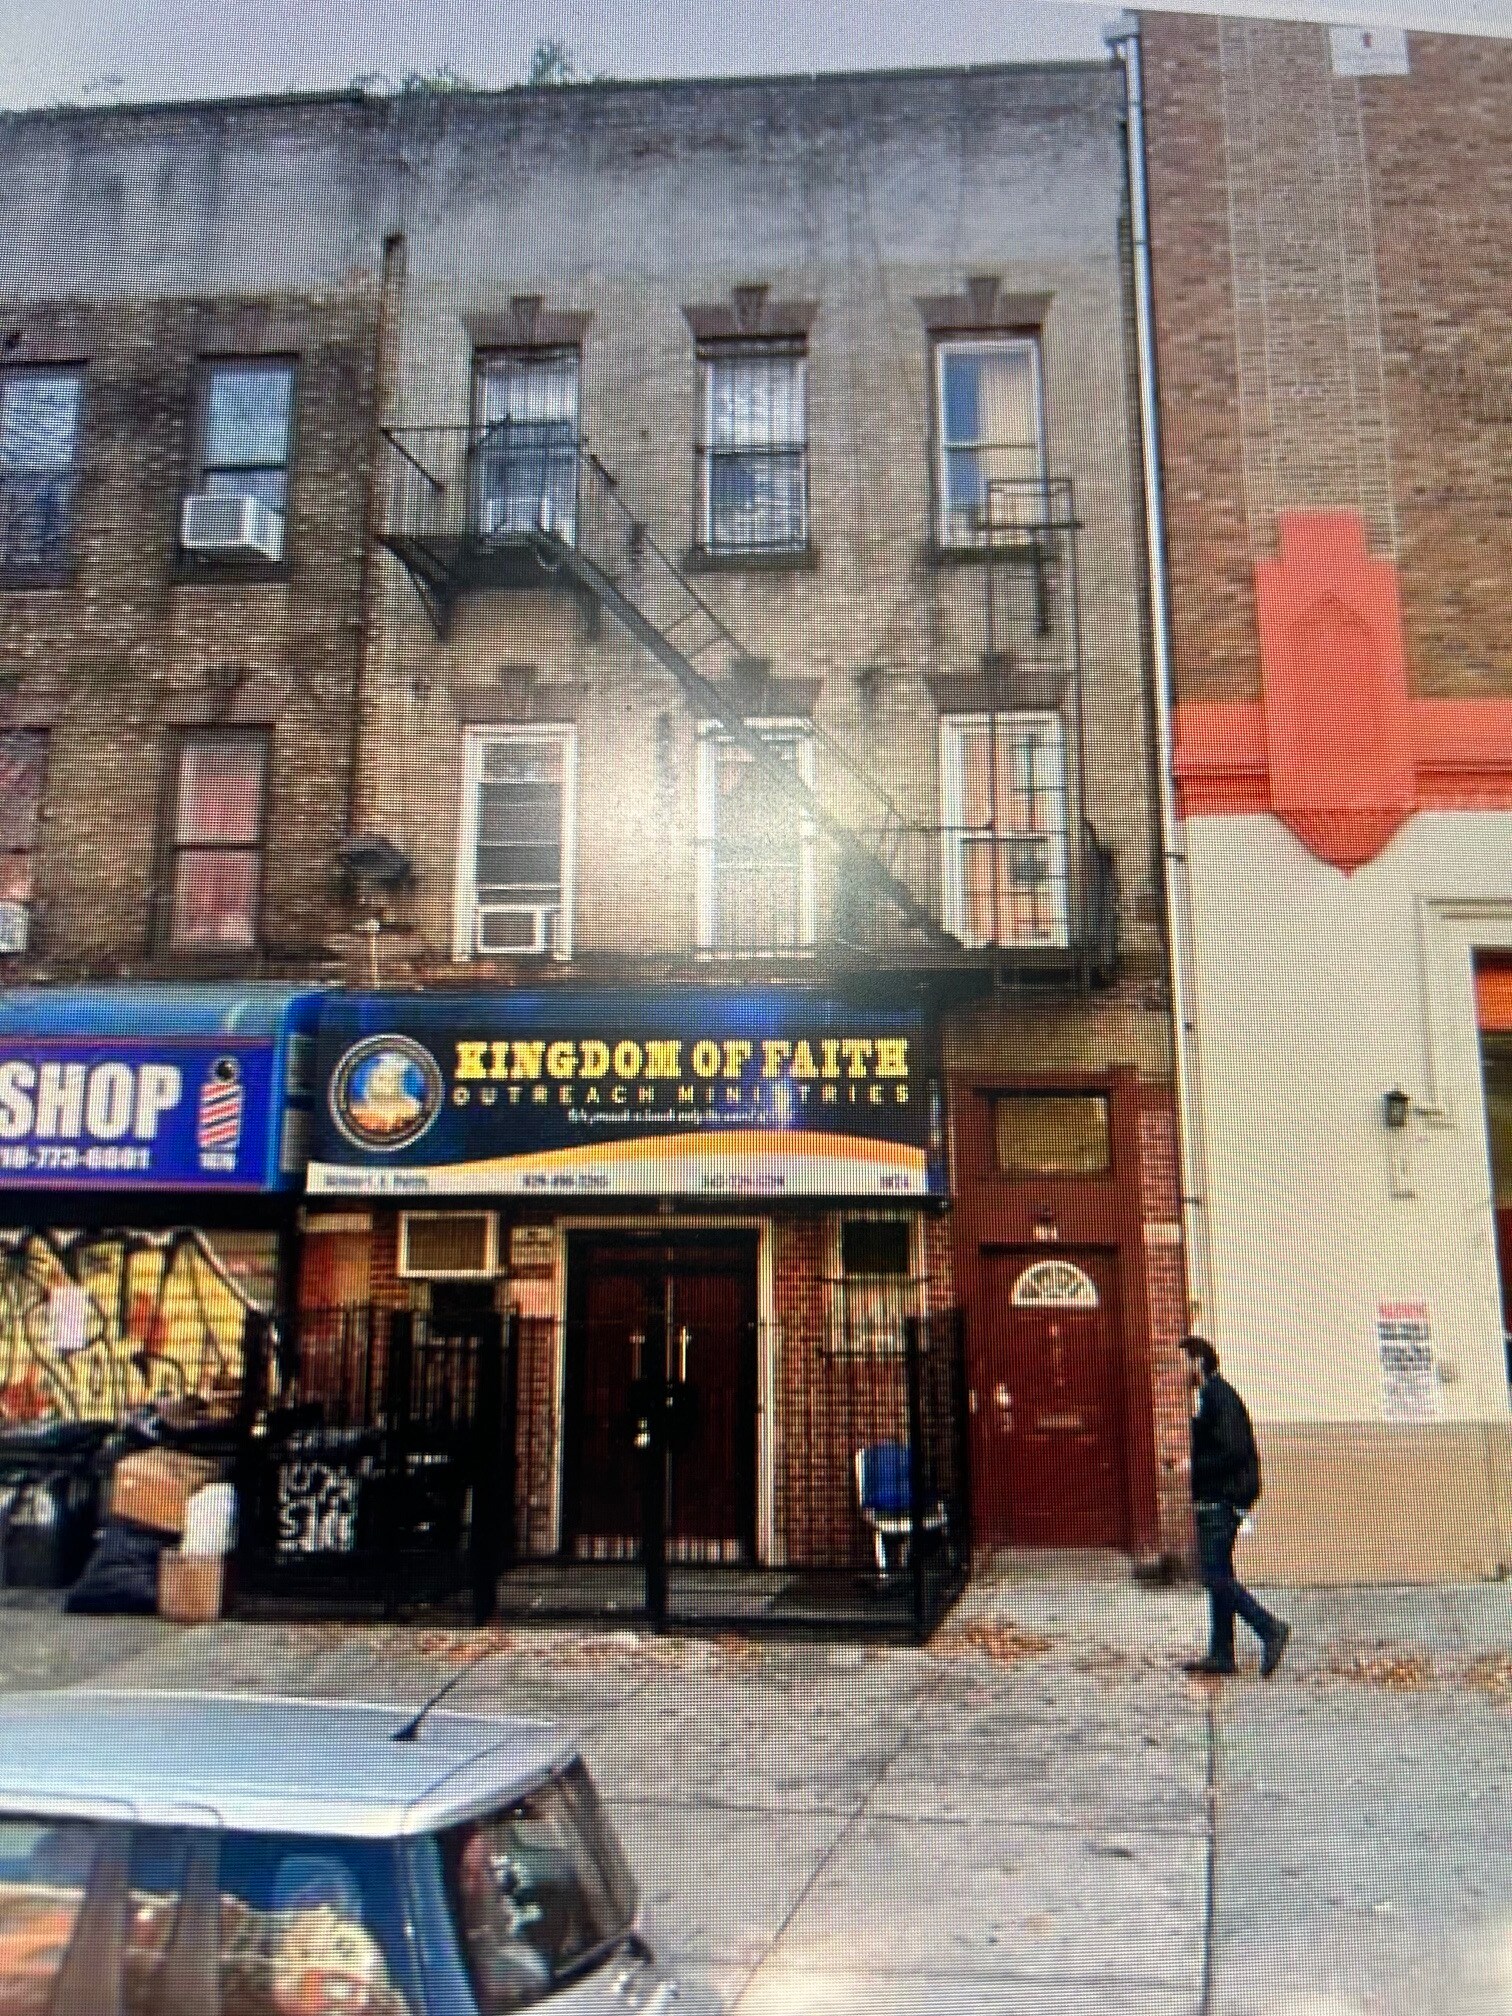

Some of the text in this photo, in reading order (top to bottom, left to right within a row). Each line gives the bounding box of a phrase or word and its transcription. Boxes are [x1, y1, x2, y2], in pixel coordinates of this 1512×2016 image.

[454, 1038, 908, 1079] KINGDOM OF FAITH
[0, 1062, 182, 1139] SHOP
[453, 1085, 654, 1105] OUTREACH
